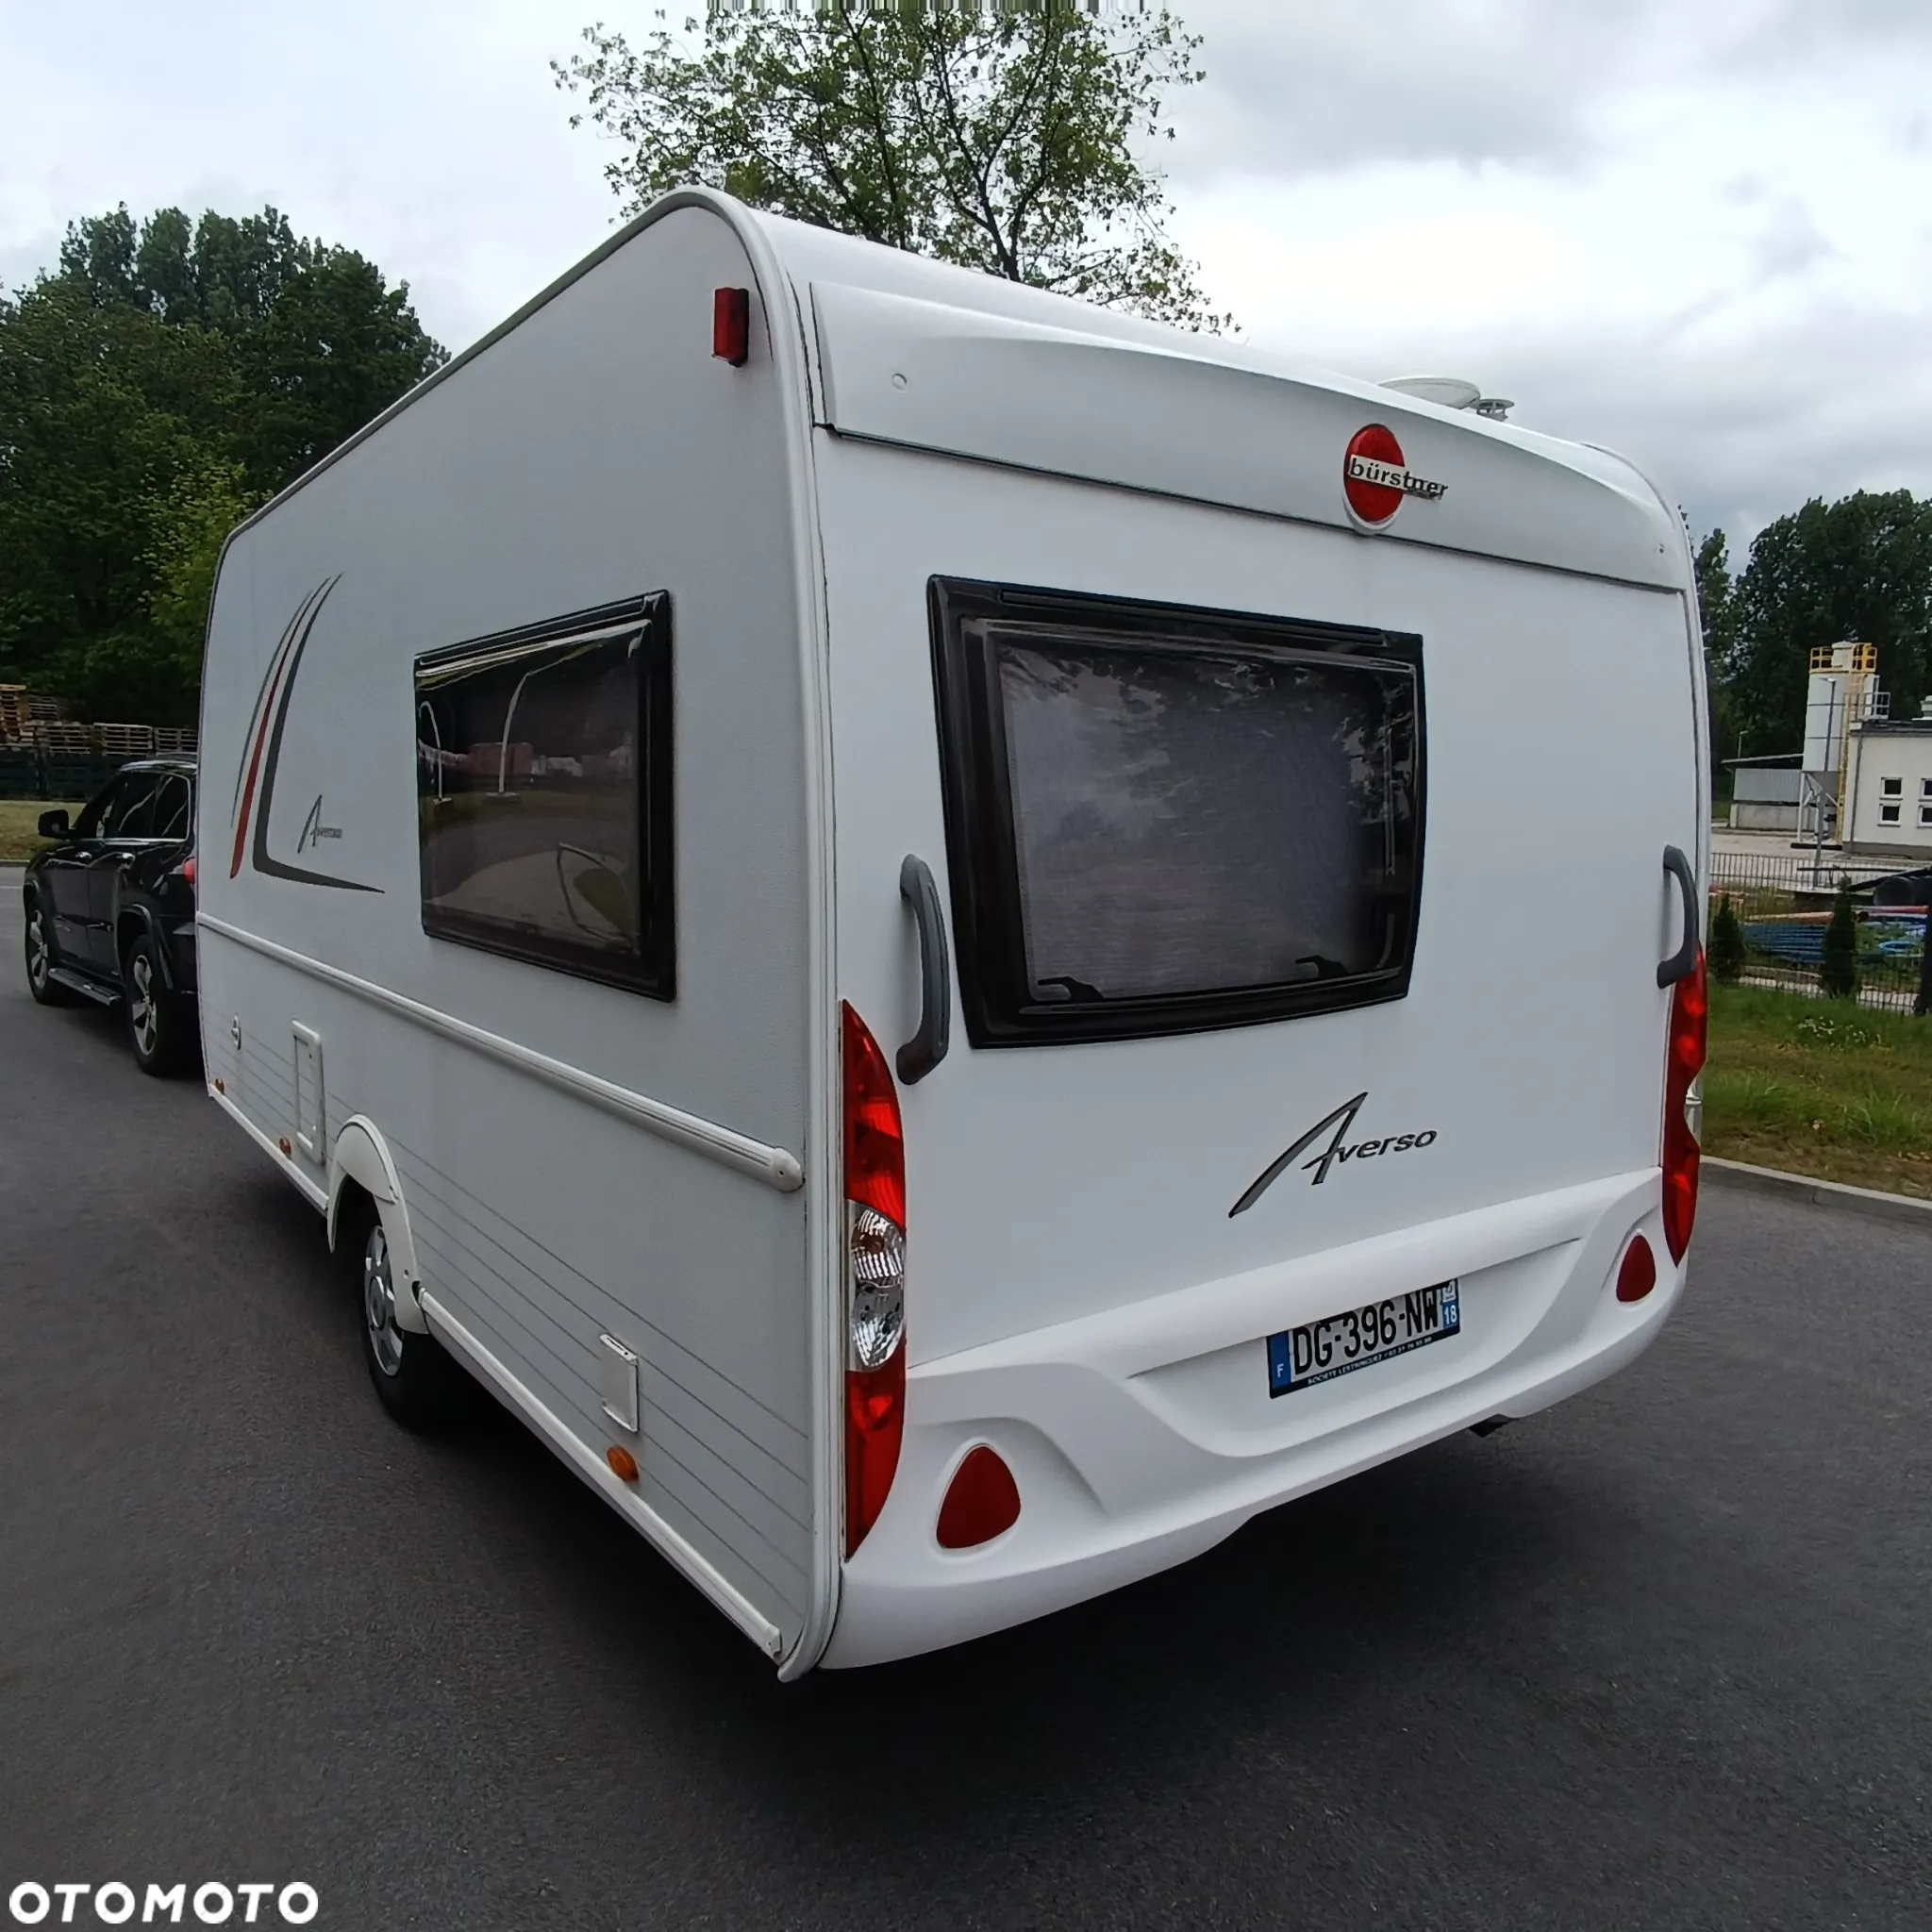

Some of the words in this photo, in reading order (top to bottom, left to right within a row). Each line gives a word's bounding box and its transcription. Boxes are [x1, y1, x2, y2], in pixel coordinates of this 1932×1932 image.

[1350, 458, 1449, 498] bürstner
[1228, 1091, 1438, 1218] Averso
[1292, 1289, 1439, 1375] DG-396-NW
[1444, 1305, 1457, 1324] 18
[1276, 1363, 1284, 1377] F
